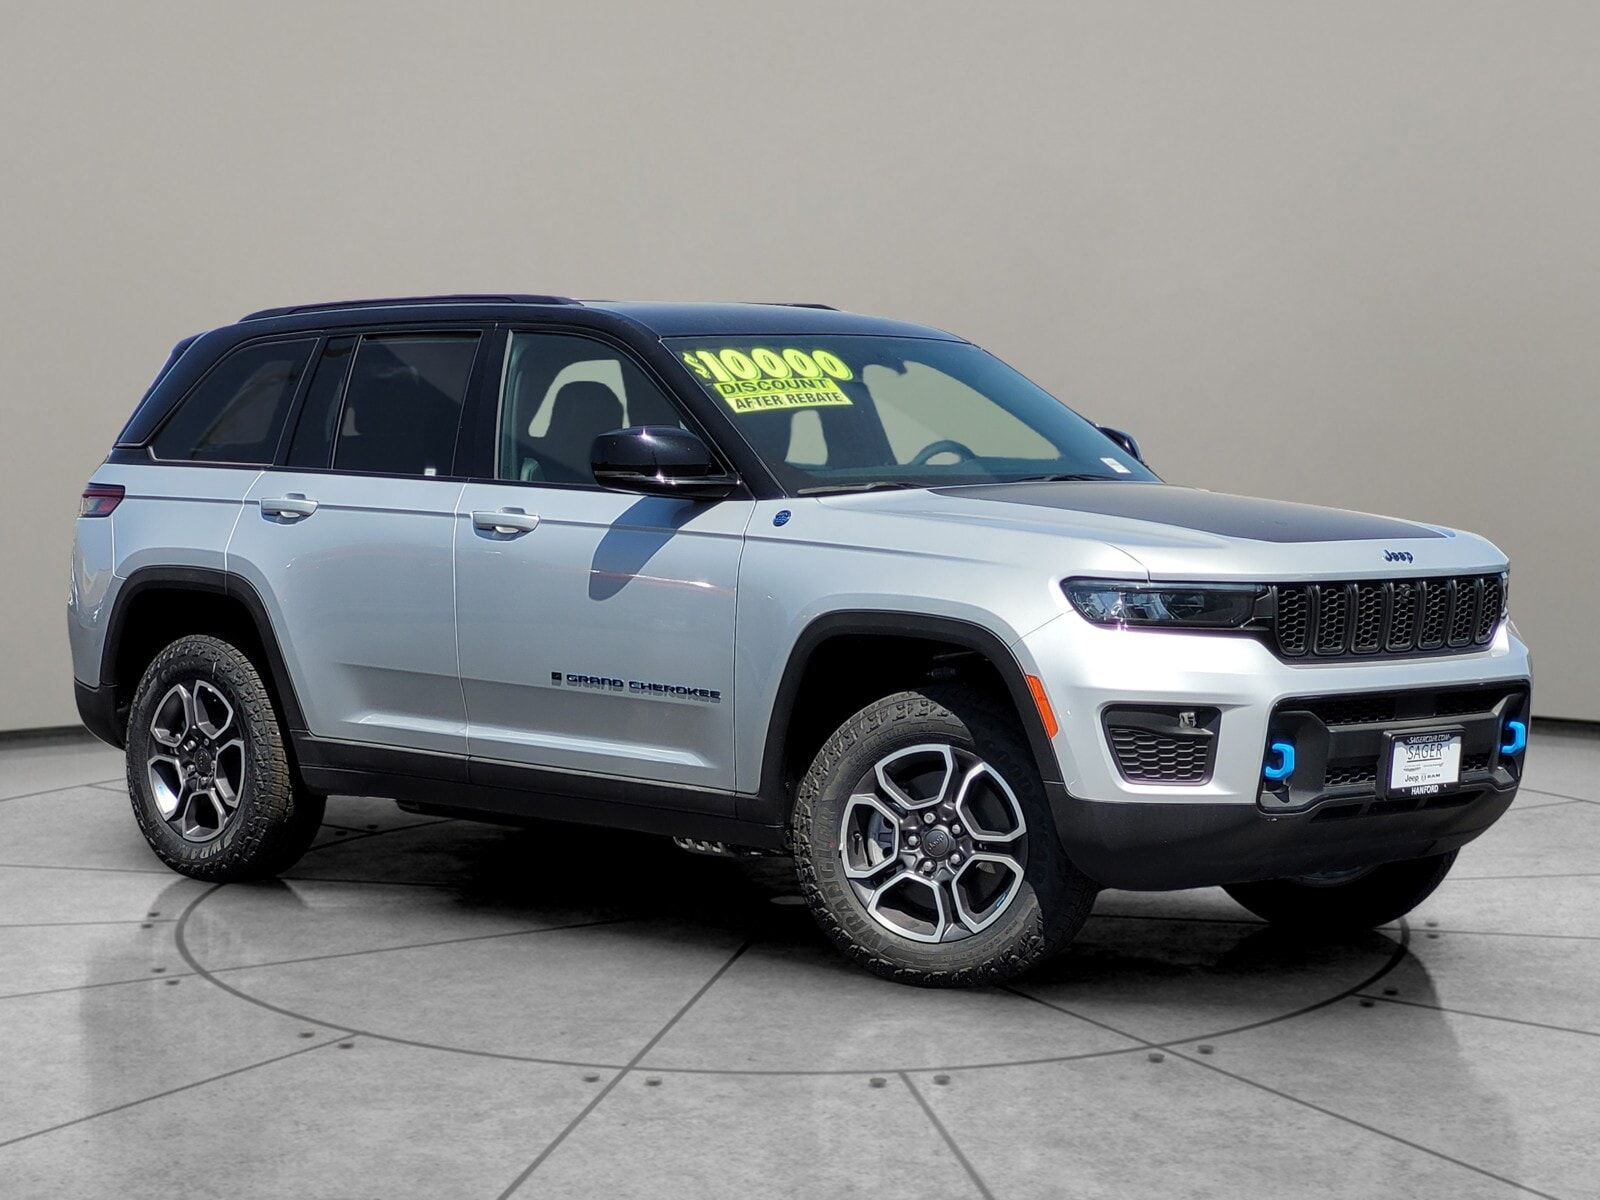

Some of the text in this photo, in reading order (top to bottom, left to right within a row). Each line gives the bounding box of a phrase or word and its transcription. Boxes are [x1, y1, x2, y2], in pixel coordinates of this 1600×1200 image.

[683, 348, 854, 382] $10000
[721, 378, 828, 395] DISCOUNT
[735, 391, 843, 410] AFTER REBATE
[1384, 549, 1414, 564] Jeep
[566, 674, 721, 700] GRAND CHEROKEE
[1407, 743, 1442, 760] SAGER
[1404, 773, 1419, 783] Jeep
[1411, 784, 1439, 795] HANFORD
